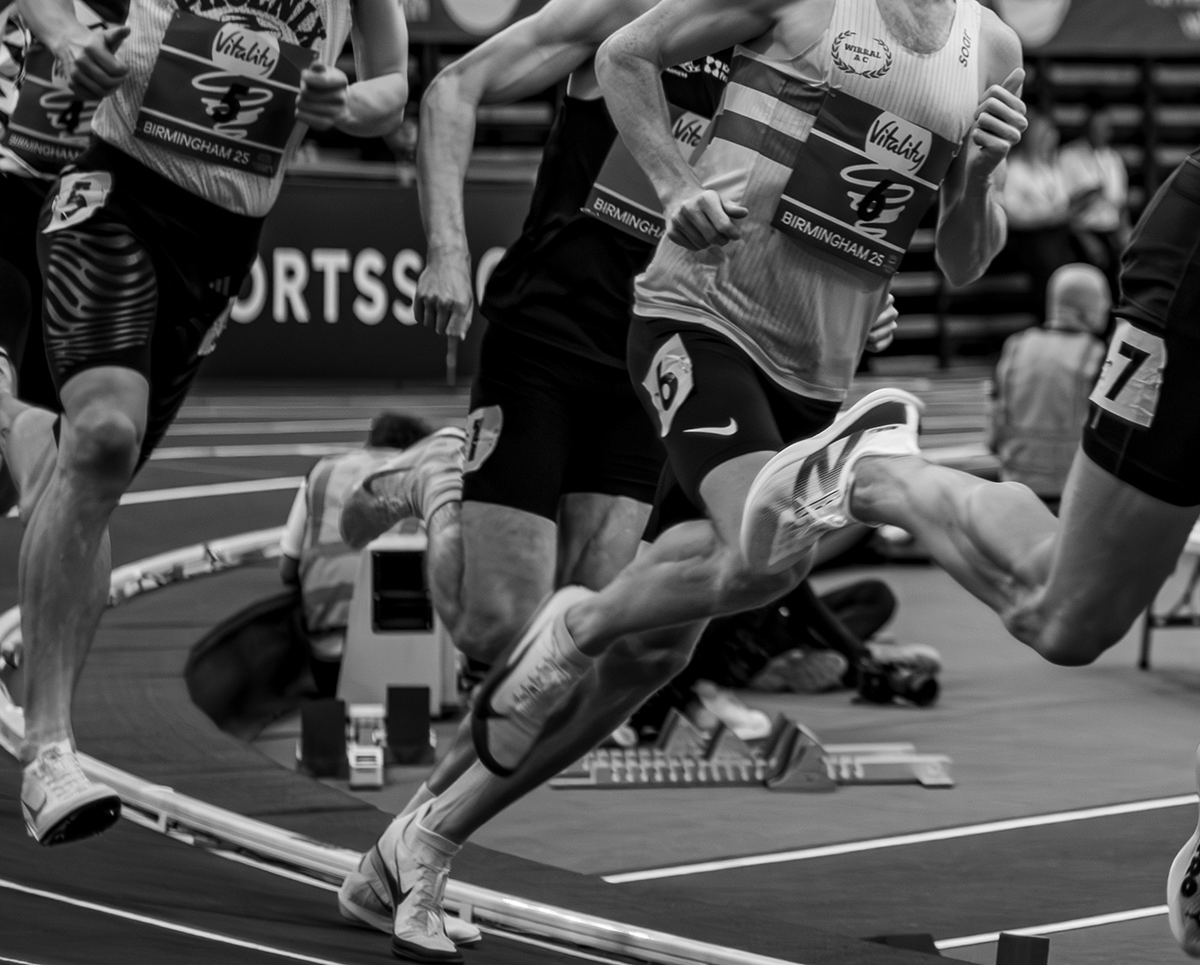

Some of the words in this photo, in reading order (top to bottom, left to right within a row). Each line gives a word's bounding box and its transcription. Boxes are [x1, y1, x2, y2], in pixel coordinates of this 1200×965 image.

[215, 31, 276, 76] Vitality
[844, 42, 882, 59] WIRRAL
[57, 100, 84, 133] 4
[210, 83, 250, 124] 5
[142, 120, 233, 160] BIRMINGHAM
[232, 150, 251, 165] 25
[673, 118, 703, 148] Vita
[869, 120, 925, 172] Vitality
[59, 181, 92, 221] 5
[856, 179, 887, 222] 6
[780, 210, 871, 261] BIRMINGHAM
[867, 251, 885, 268] 25
[230, 246, 506, 326] ORTSS
[656, 360, 679, 412] 6
[1105, 340, 1152, 402] 7
